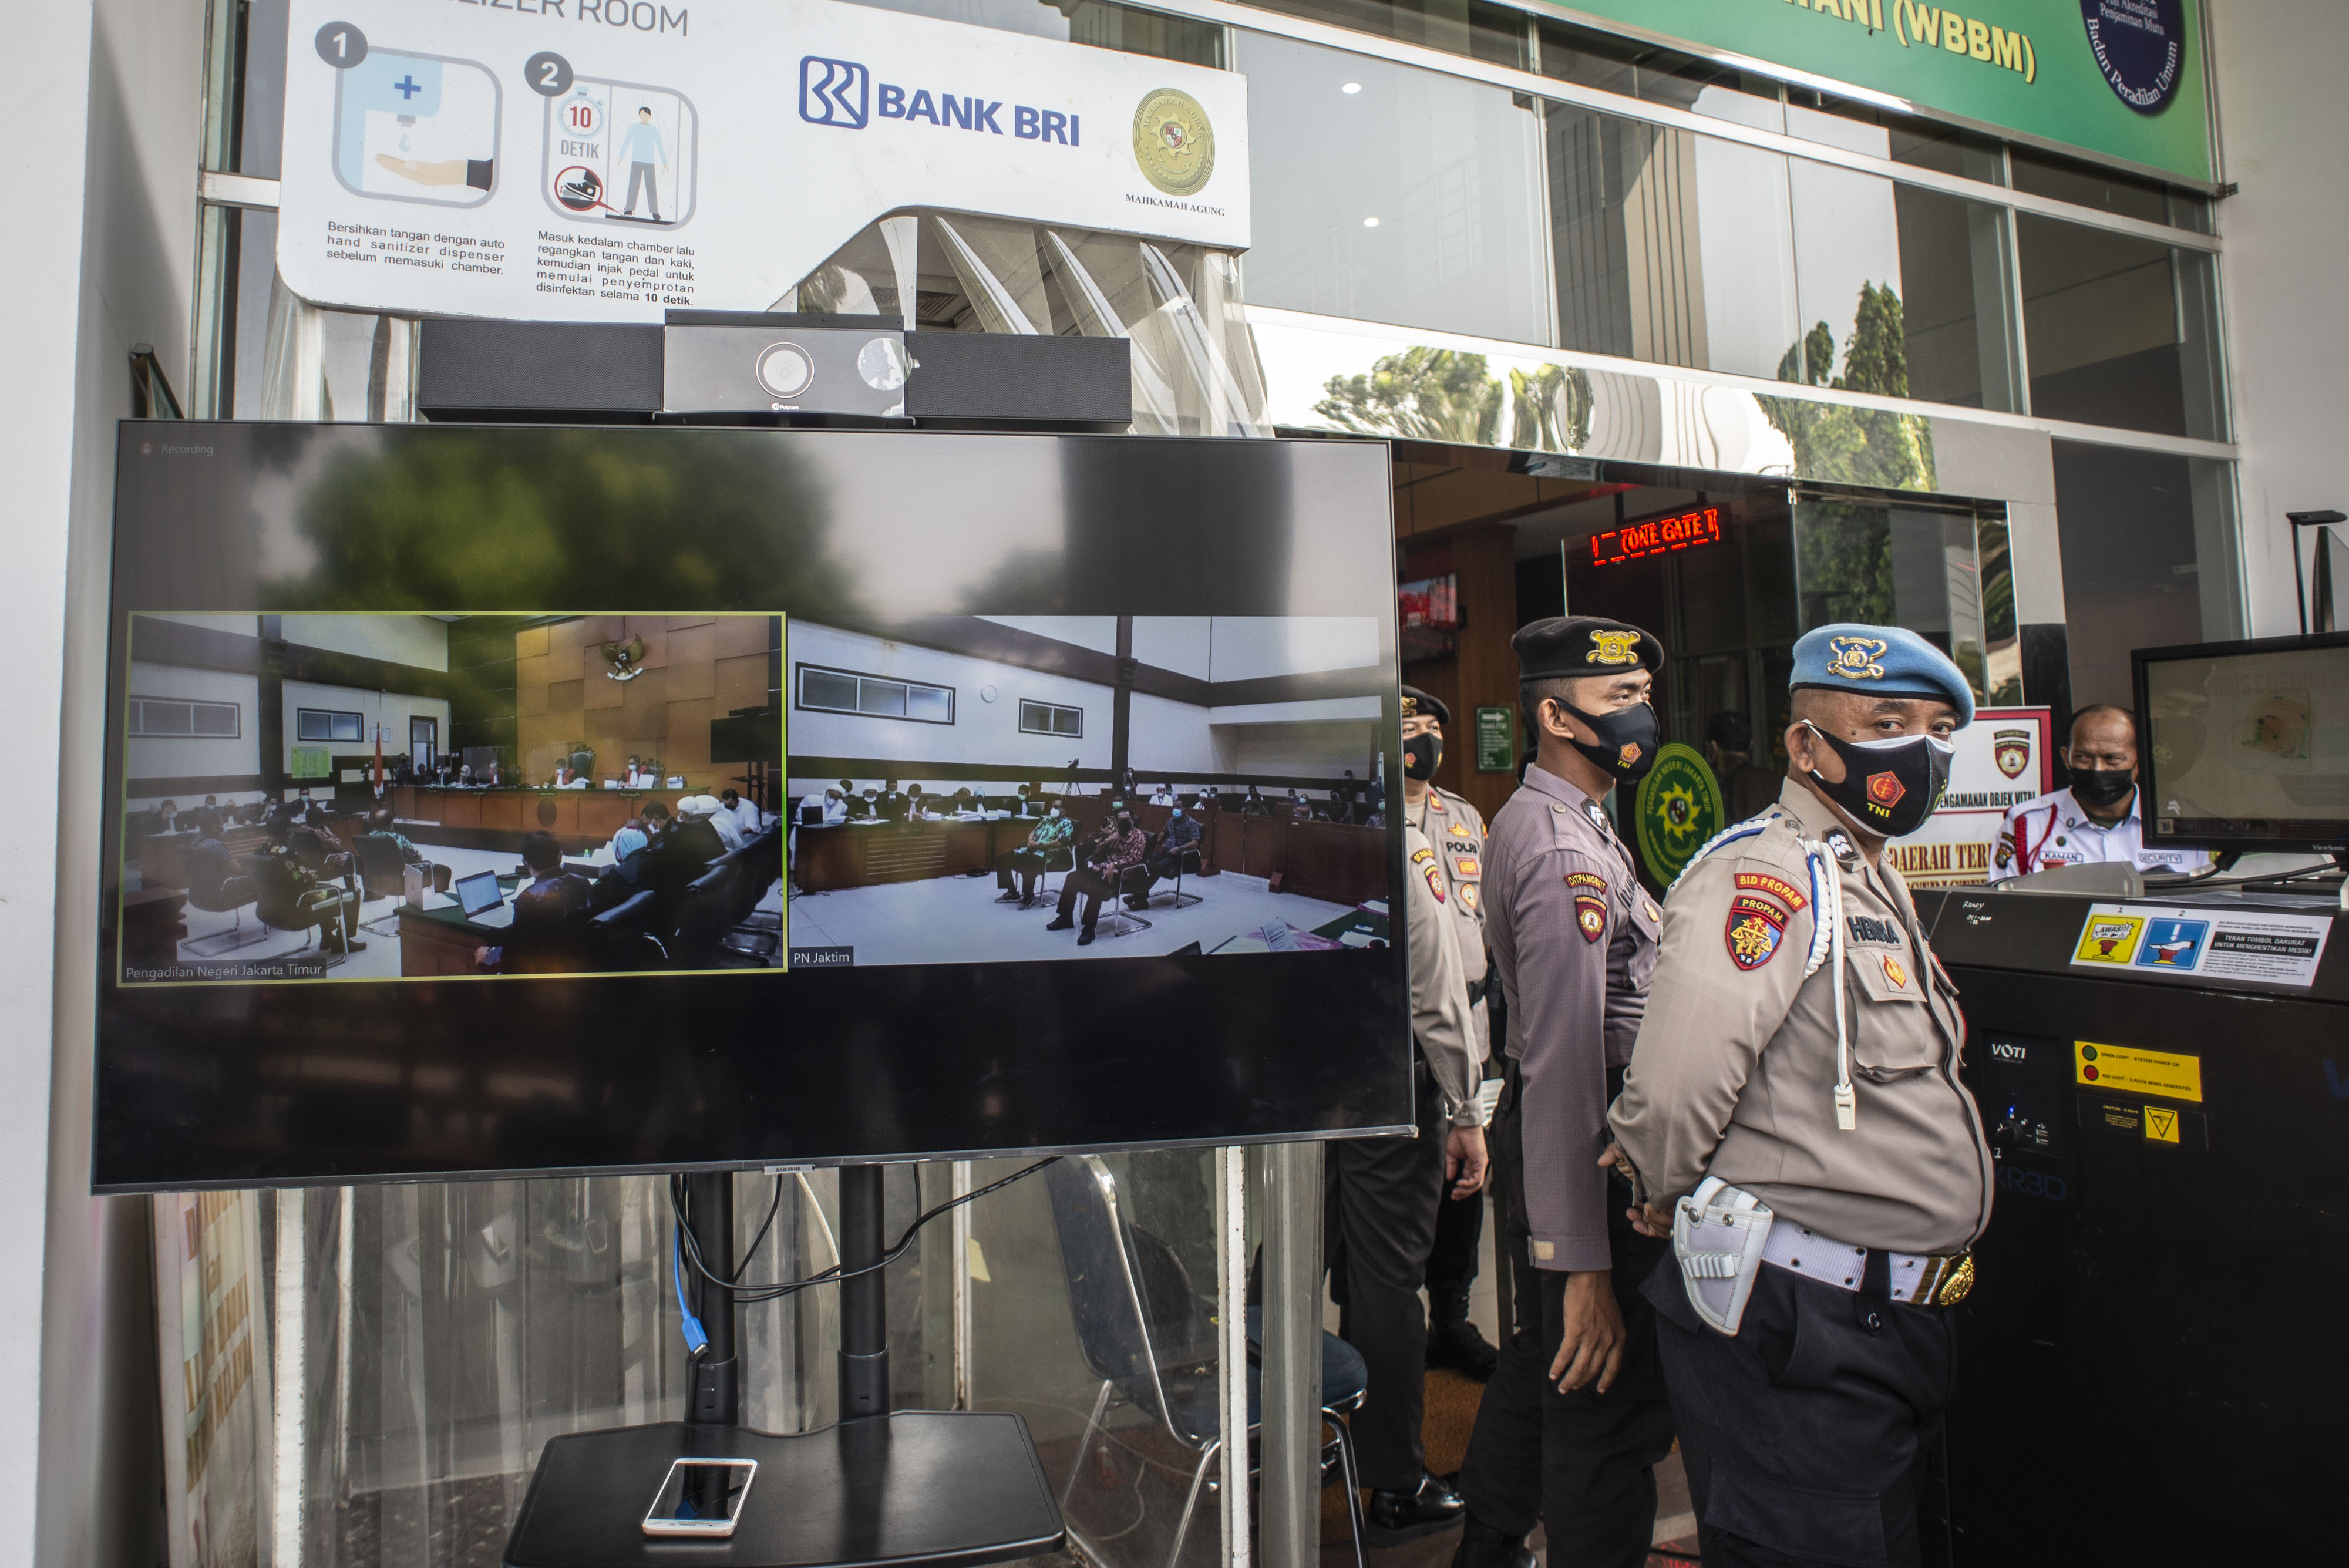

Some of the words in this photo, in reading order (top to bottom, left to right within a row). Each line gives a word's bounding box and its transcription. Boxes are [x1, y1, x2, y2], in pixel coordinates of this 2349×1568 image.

[578, 0, 688, 36] ROOM
[2100, 2, 2143, 28] Penjaminan
[2144, 16, 2165, 35] Mutu
[2122, 0, 2158, 19] Akreditasi
[332, 32, 347, 58] 1
[1893, 0, 2035, 84] (WBBM)
[2086, 17, 2112, 73] Badan
[2110, 69, 2162, 105] Peradilan
[2155, 41, 2178, 91] Umum
[540, 62, 558, 87] 2
[570, 106, 591, 128] 10
[878, 82, 1004, 136] BANK
[1014, 106, 1080, 147] BRI
[561, 140, 599, 159] DETIK
[1126, 194, 1187, 210] MAHKAMAH
[1190, 203, 1225, 216] AGUNG
[328, 221, 386, 235] Bersihkan
[391, 228, 430, 241] tangan
[434, 233, 476, 247] dengan
[480, 238, 505, 249] auto
[538, 230, 574, 243] Masuk
[578, 235, 624, 249] kedalam
[627, 241, 674, 254] chamber
[677, 245, 695, 256] lalu
[328, 235, 361, 247] hand
[371, 241, 430, 254] sanitizer
[440, 247, 505, 262] dispenser
[538, 244, 595, 259] regangkan
[602, 251, 638, 264] tangan
[645, 255, 664, 265] dan
[671, 257, 695, 270] kaki,
[327, 249, 376, 263] sebelum
[385, 255, 444, 269] memasuki
[451, 261, 504, 275] chamber.
[537, 257, 590, 271] kemudian
[598, 263, 622, 275] injak
[630, 266, 658, 278] pedal
[665, 270, 694, 281] untuk
[537, 270, 592, 284] memulai
[602, 277, 694, 293] penyemprotan
[536, 282, 595, 297] disinfektan
[601, 290, 639, 301] selama
[645, 292, 658, 302] 10
[663, 295, 694, 306] detik.
[161, 444, 214, 456] Recording
[1618, 760, 1631, 769] TNI
[1867, 802, 1890, 817] TNI
[1940, 792, 1988, 808] ENGAMANAN
[1990, 792, 2013, 806] OBJEK
[1888, 844, 1951, 871] DAERAH
[1956, 843, 1993, 869] TER
[2045, 852, 2077, 860] KAMAN
[1739, 876, 1758, 885] BID
[1760, 877, 1803, 907] PROPAM
[1742, 899, 1784, 921] PROPAM
[2236, 943, 2287, 952] MENGHENTIKAN
[2247, 936, 2273, 944] TOMBOL
[794, 951, 810, 963] PN
[813, 950, 850, 963] Jaktim
[126, 967, 193, 980] Pengadilan
[197, 965, 238, 978] Negeri
[241, 964, 284, 976] Jakarta
[287, 963, 322, 975] Timur
[1991, 1043, 2026, 1059] VOTI
[2163, 1082, 2192, 1091] GENERATED
